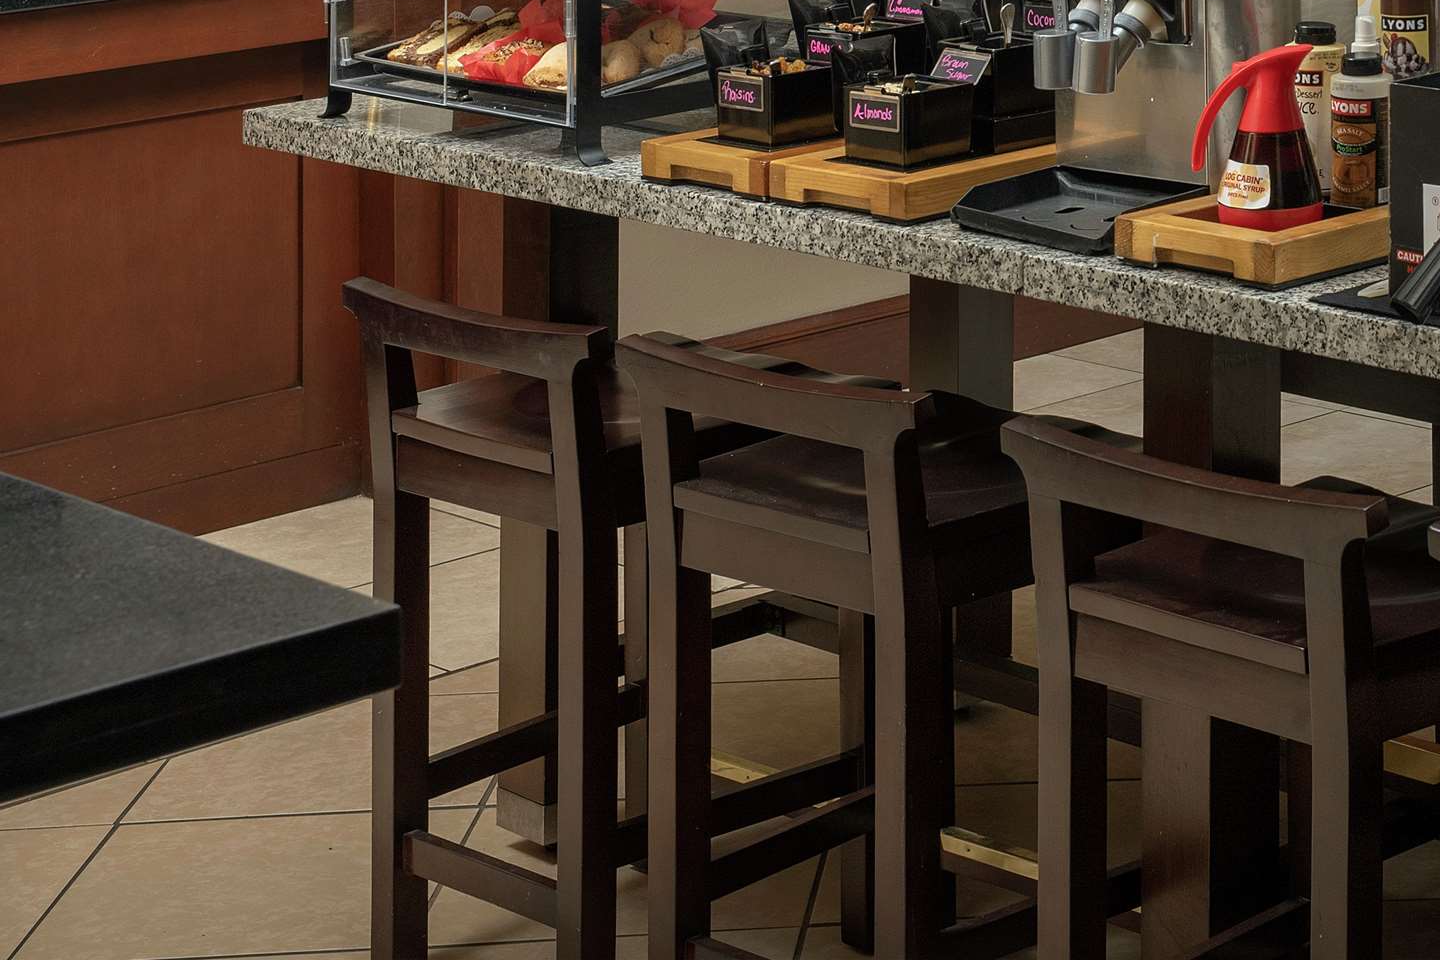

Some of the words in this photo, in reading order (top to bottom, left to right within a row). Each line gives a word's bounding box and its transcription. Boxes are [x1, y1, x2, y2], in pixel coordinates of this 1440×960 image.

[1027, 9, 1056, 27] Cocon
[1382, 19, 1425, 30] LYONS
[854, 102, 893, 121] Almonds
[1331, 100, 1368, 114] LYONS
[1397, 250, 1424, 262] CAUTI
